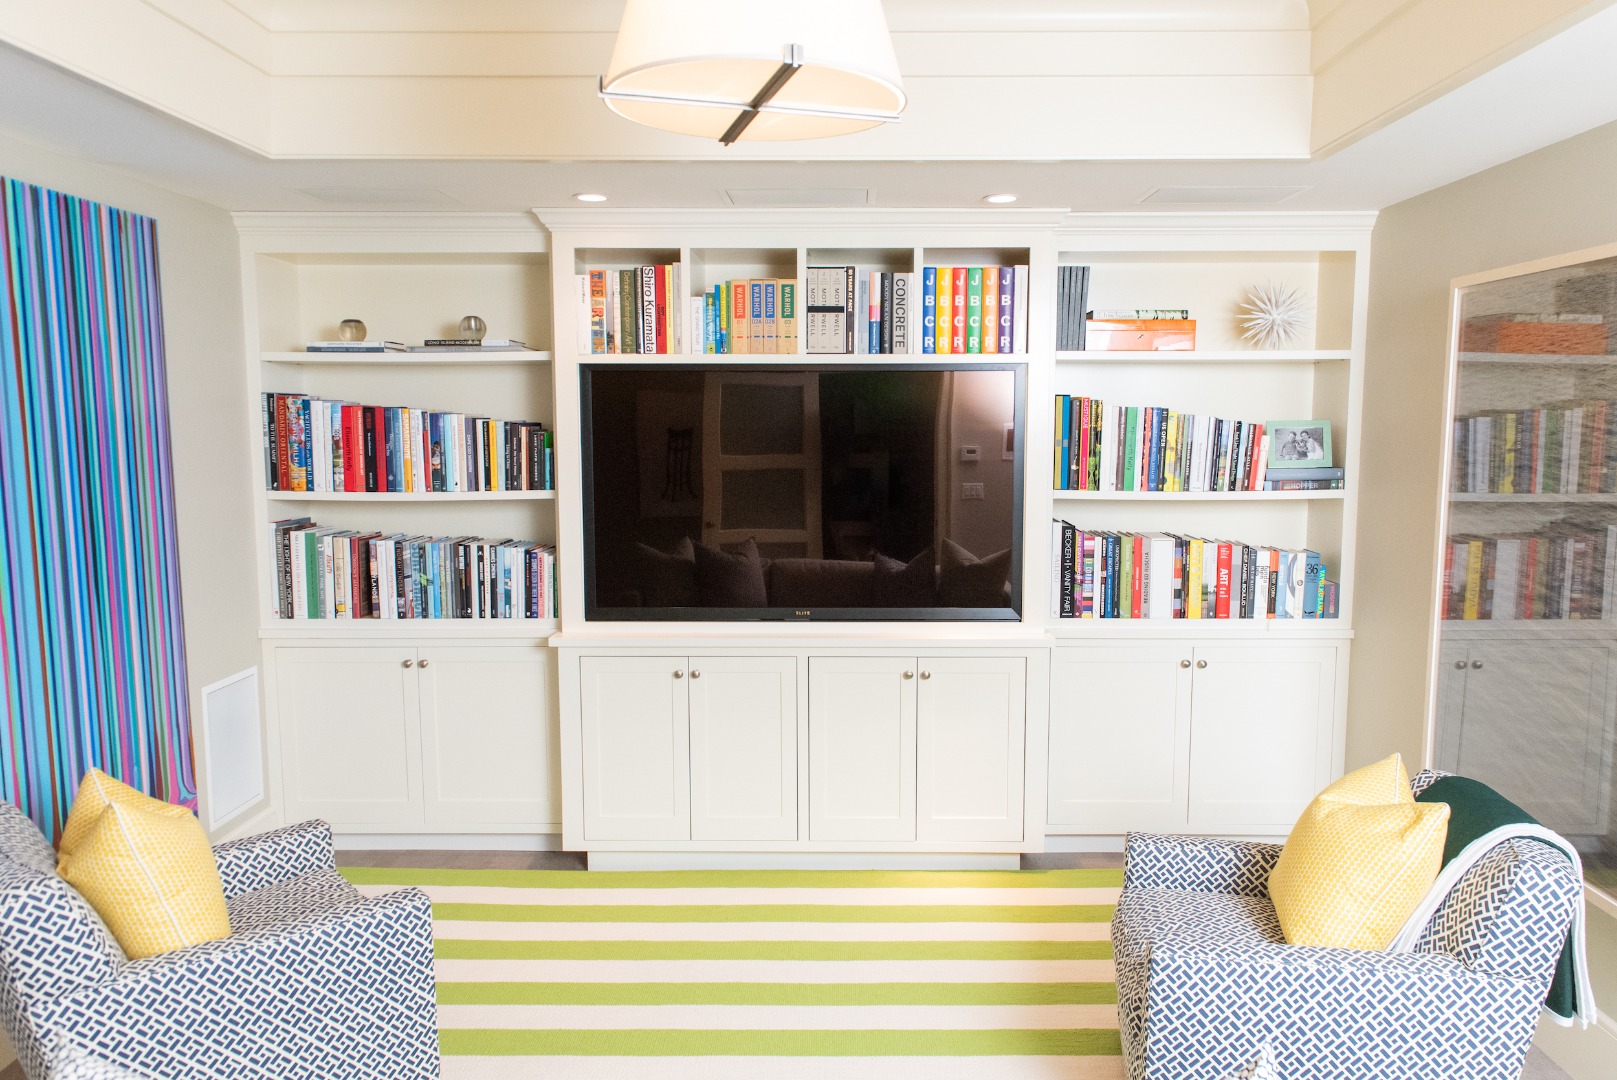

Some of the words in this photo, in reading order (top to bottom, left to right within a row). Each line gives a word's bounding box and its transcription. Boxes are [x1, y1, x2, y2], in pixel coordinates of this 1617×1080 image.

[592, 271, 604, 297] THE
[622, 272, 631, 295] Defining
[644, 268, 654, 297] Shiro
[591, 299, 605, 329] ART
[622, 295, 632, 336] Contemporary
[645, 300, 655, 352] Kuramata
[895, 278, 906, 348] CONCRETE
[625, 336, 633, 345] Art
[402, 413, 410, 460] SAMARITAINE
[1126, 457, 1134, 472] Kelly
[285, 564, 290, 572] OF
[412, 544, 420, 573] SURF
[1191, 543, 1200, 565] ART
[1220, 568, 1228, 586] ART
[1306, 564, 1318, 574] 36
[413, 580, 422, 618] SHACK
[1192, 575, 1200, 608] TODAY
